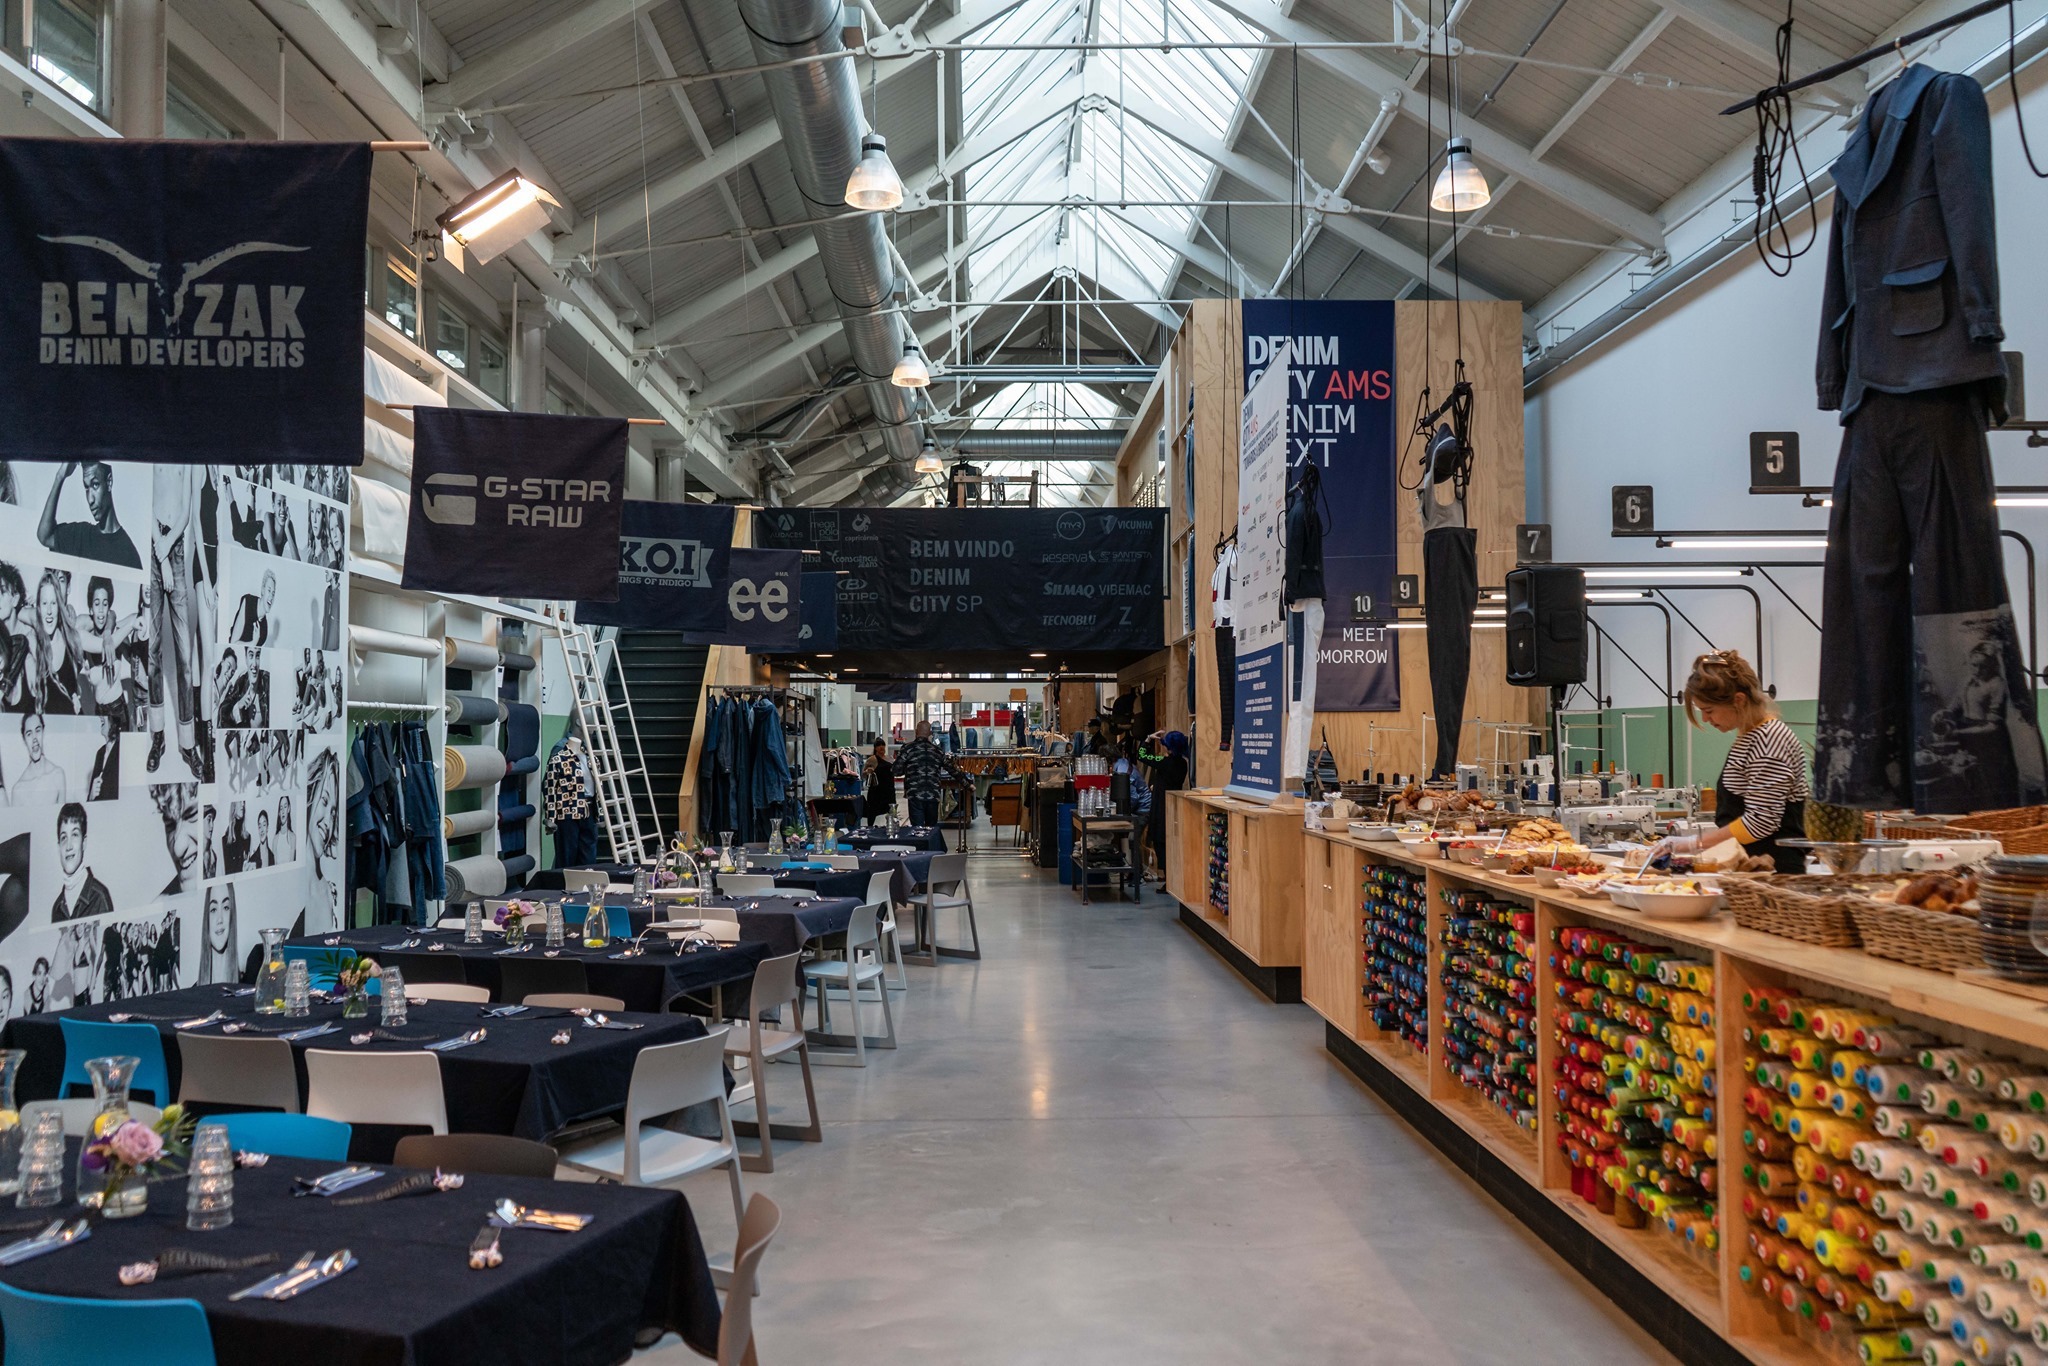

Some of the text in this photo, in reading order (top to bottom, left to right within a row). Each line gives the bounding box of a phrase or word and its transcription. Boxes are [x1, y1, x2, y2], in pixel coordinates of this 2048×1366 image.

[41, 281, 305, 338] BEN ZAK
[39, 337, 305, 367] DENIM DEVELOPERS
[1248, 335, 1339, 365] DENIM
[1324, 369, 1391, 400] AMS
[1286, 404, 1356, 434] NIM
[1766, 440, 1784, 474] 5
[484, 476, 611, 503] G-STAR
[507, 504, 583, 528] RAW
[1625, 495, 1641, 524] 6
[1118, 520, 1153, 529] VICUNHA
[910, 540, 1015, 558] BEM VINDO
[1527, 530, 1541, 554] 7
[1112, 551, 1153, 559] SANTISTA
[644, 577, 658, 585] OF
[658, 579, 692, 587] INDIGO
[910, 568, 970, 586] DENIM
[835, 592, 879, 601] IOTIPO
[1043, 582, 1151, 598] SILMAQ VIBEMAC
[1399, 580, 1411, 599] 9
[728, 578, 789, 622] ee
[909, 595, 983, 613] CITY SP
[1354, 595, 1372, 613] 10
[1119, 606, 1132, 625] Z
[1343, 627, 1387, 642] MEET
[1316, 649, 1388, 664] MORROW
